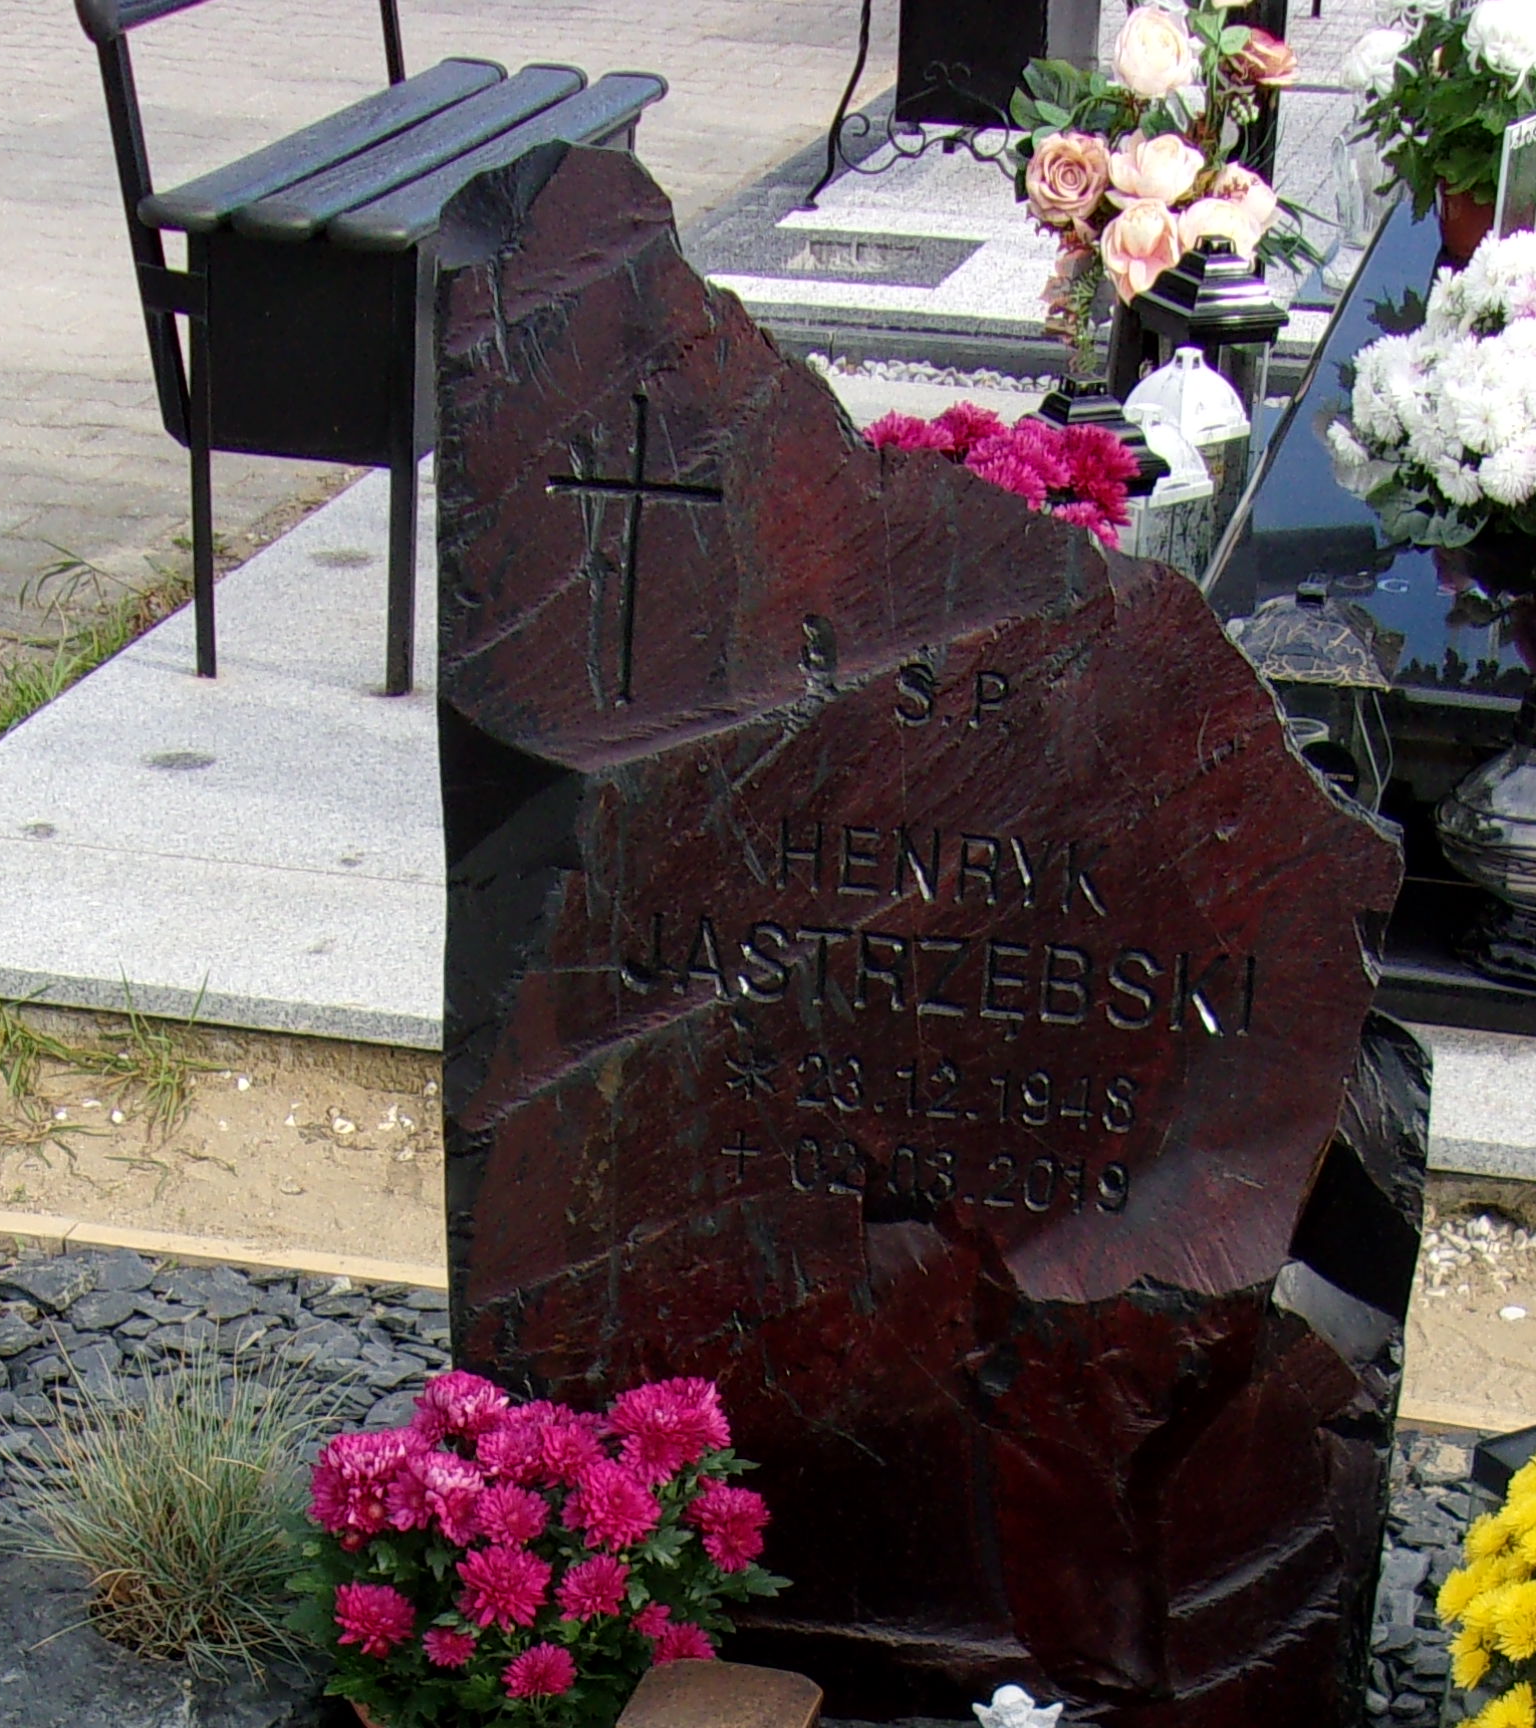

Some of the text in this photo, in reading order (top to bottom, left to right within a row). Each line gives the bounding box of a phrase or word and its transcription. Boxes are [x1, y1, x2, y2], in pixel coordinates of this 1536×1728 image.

[776, 818, 1107, 917] HENRYK
[619, 912, 1256, 1041] JASTRZĘBSKI
[794, 1051, 1139, 1135] 23.12.1948
[789, 1134, 1130, 1216] 0203.2019
